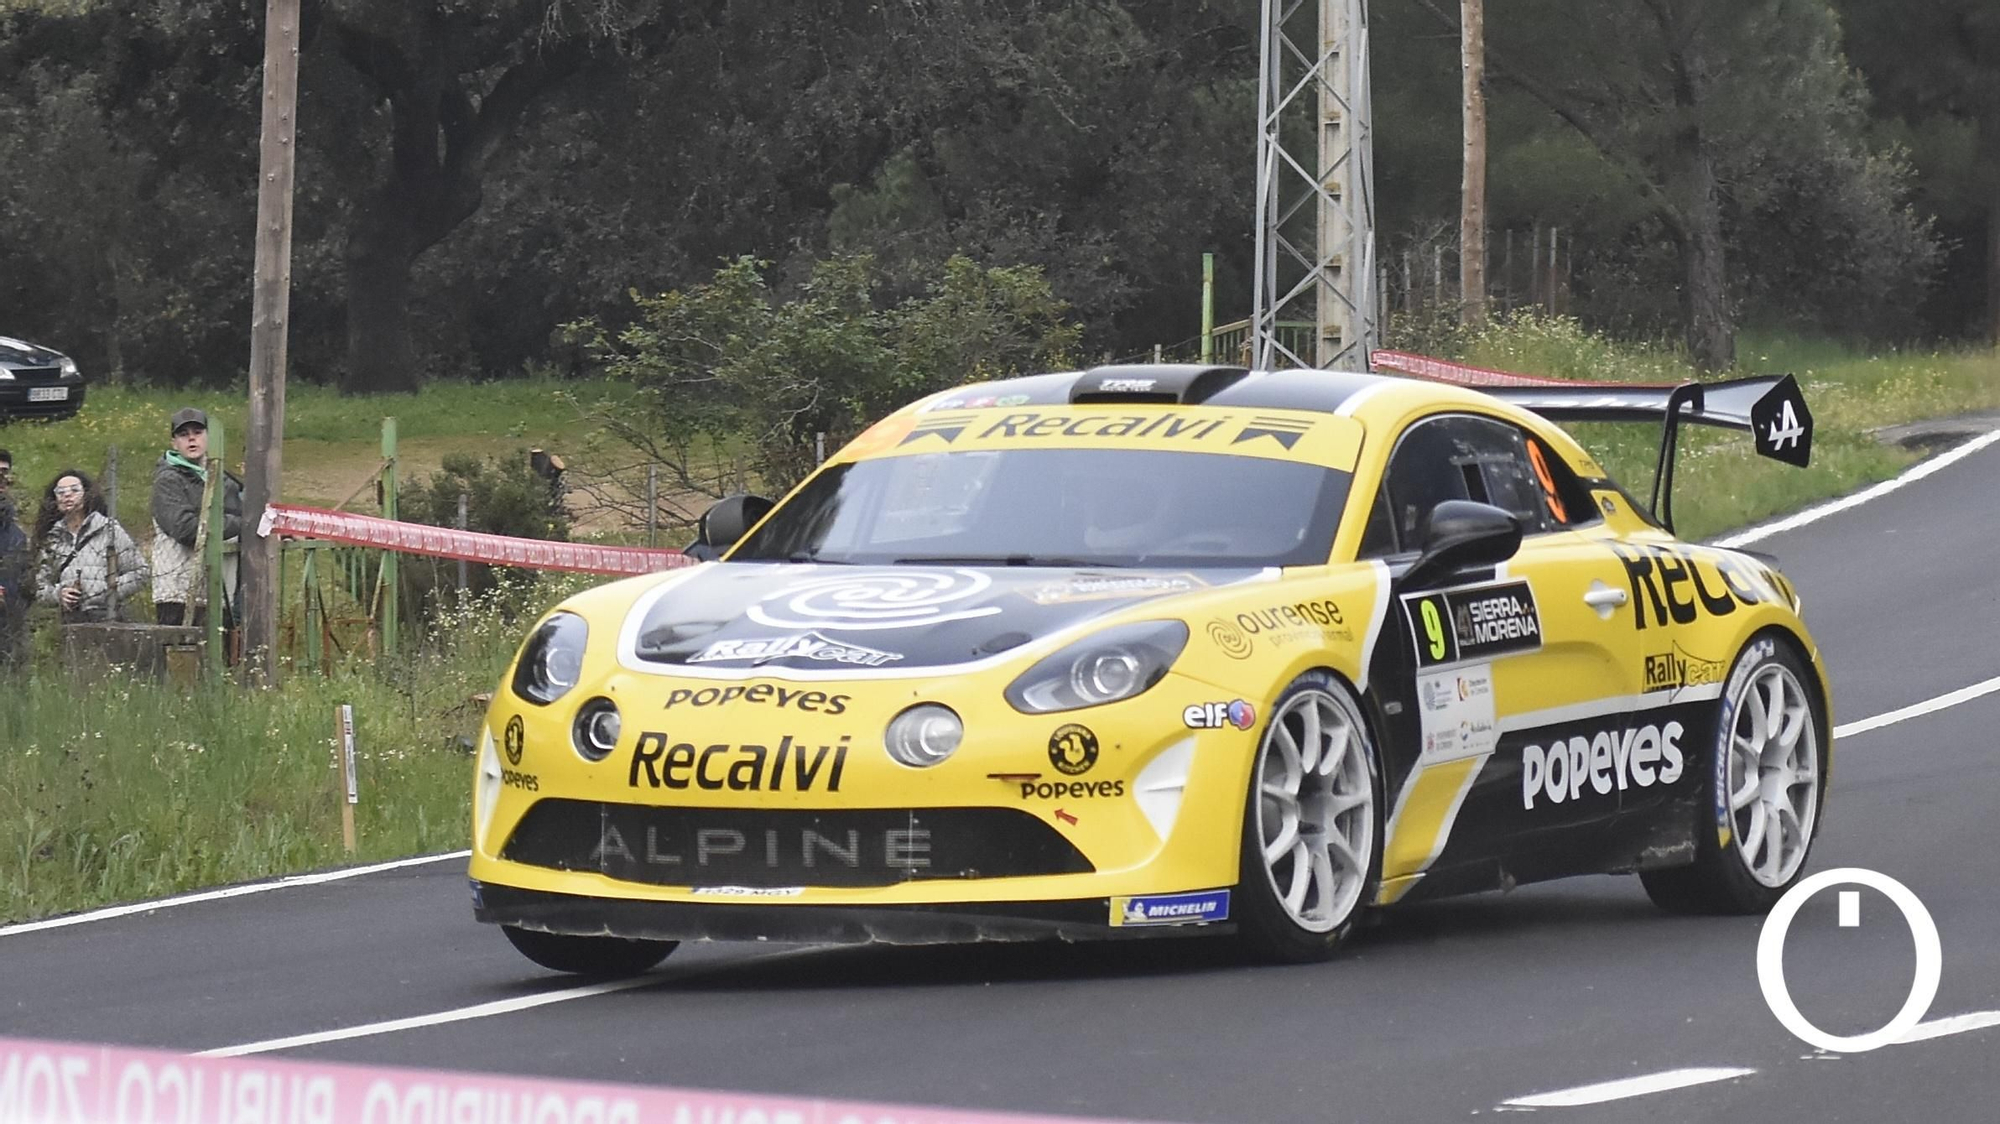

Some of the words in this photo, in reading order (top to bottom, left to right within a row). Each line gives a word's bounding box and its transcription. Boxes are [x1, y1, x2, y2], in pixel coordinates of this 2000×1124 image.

[977, 412, 1228, 440] Recalvi
[1237, 598, 1344, 634] ourense
[1469, 596, 1522, 622] SIERRA
[1420, 599, 1445, 660] 9
[1474, 615, 1538, 644] MORENA
[1183, 704, 1228, 729] elf
[629, 731, 852, 792] Recalvi
[589, 824, 931, 868] ALPINE
[1148, 901, 1217, 918] MICHELIN
